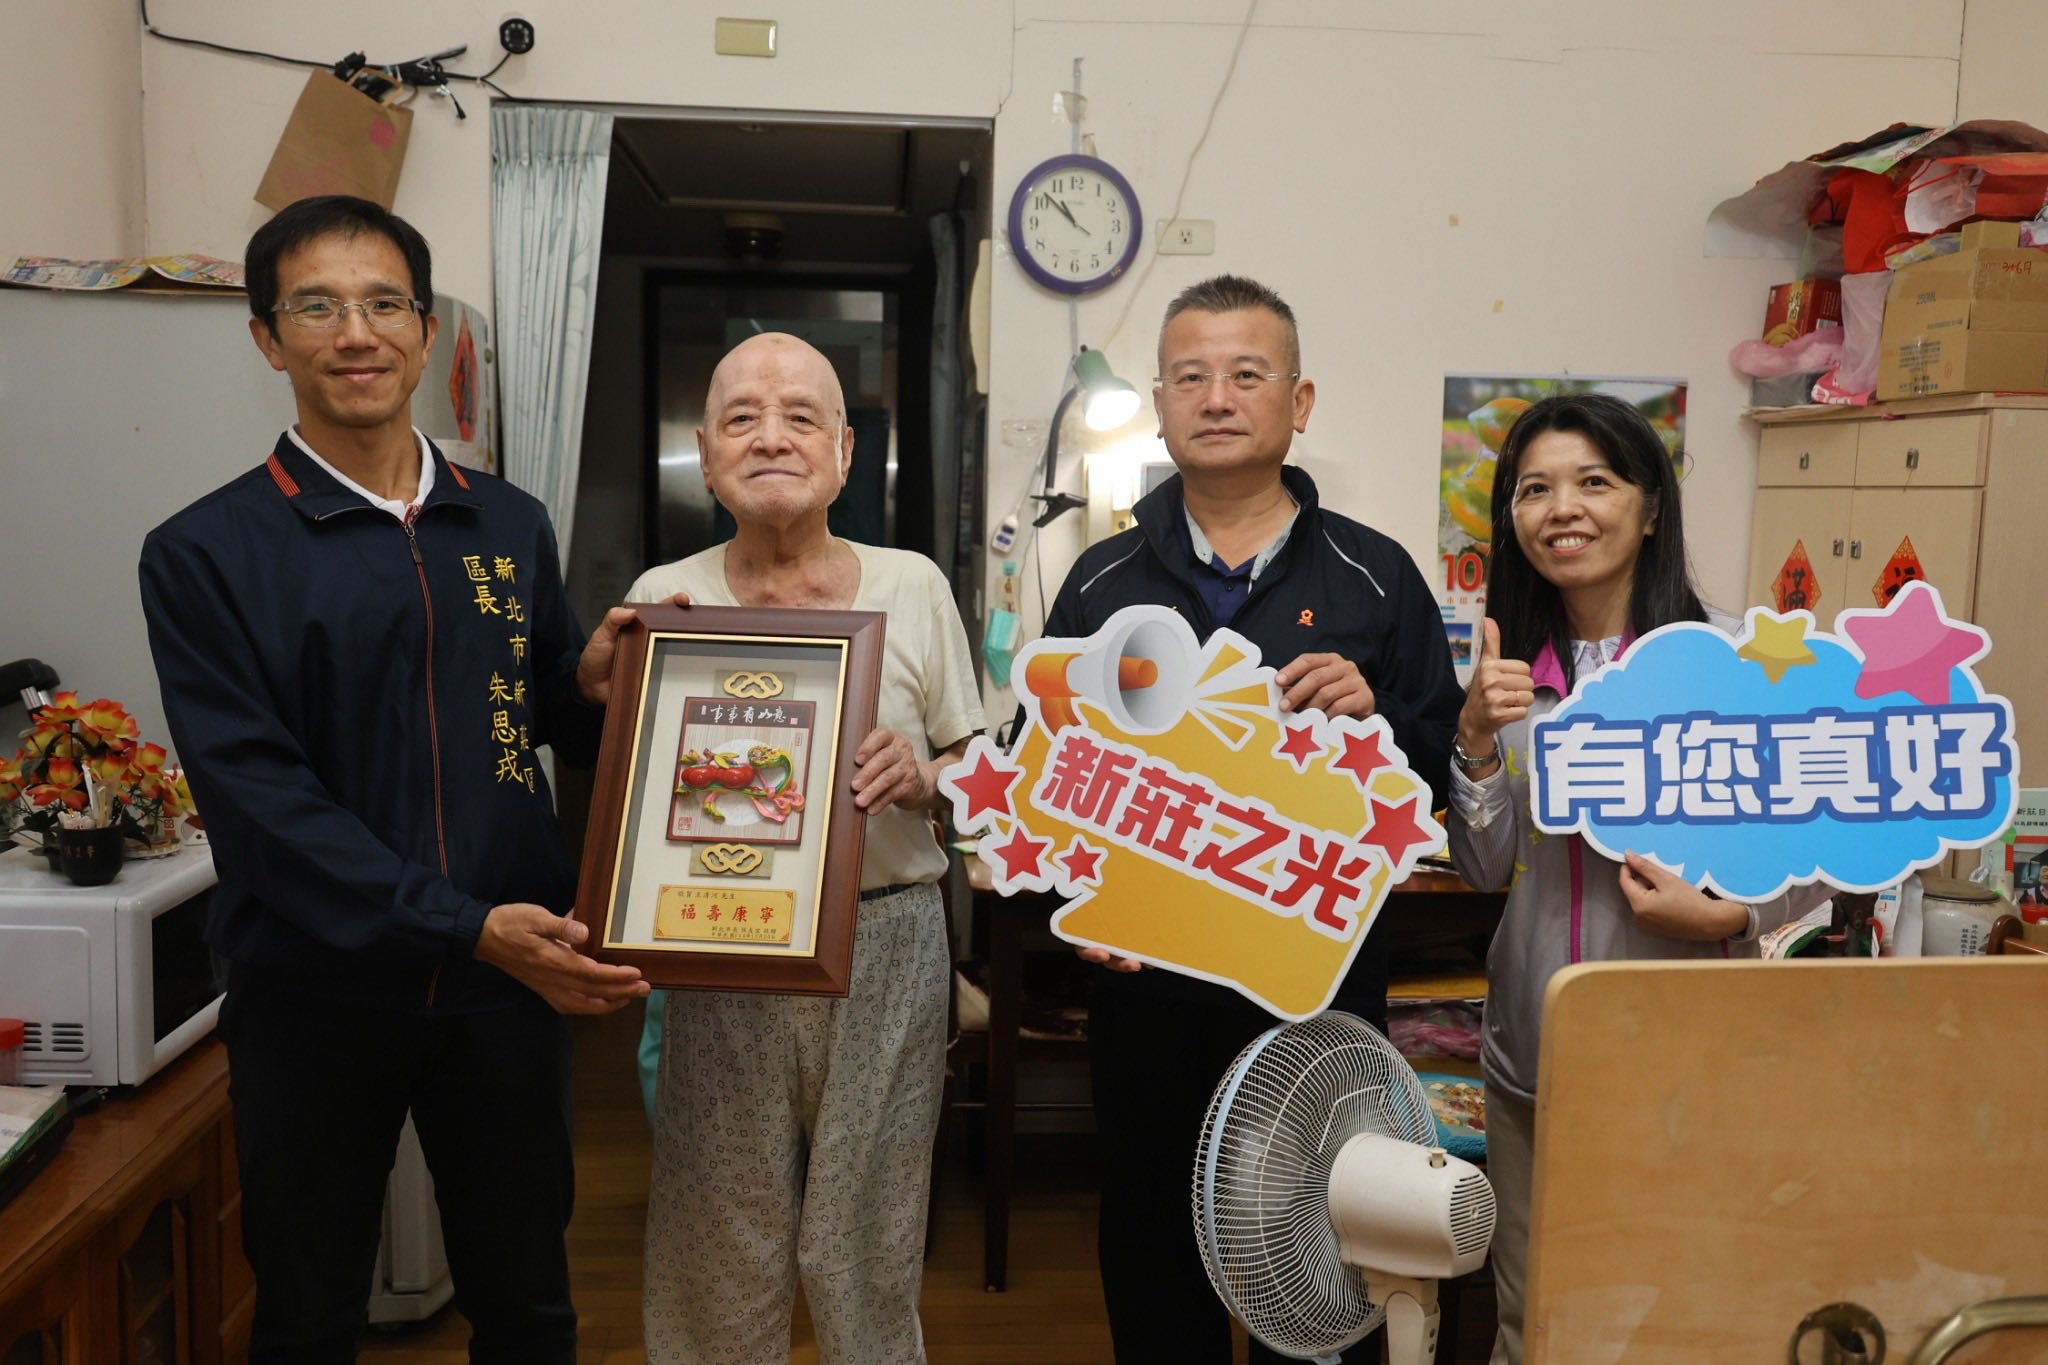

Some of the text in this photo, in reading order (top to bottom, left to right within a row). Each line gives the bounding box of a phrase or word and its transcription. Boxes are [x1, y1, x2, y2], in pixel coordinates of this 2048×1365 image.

[1052, 179, 1064, 193] 11
[1070, 176, 1084, 190] 12
[1096, 183, 1101, 197] 1
[1034, 196, 1049, 210] 10
[1107, 199, 1116, 213] 2
[1029, 216, 1039, 231] 9
[1112, 220, 1121, 234] 3
[1035, 239, 1045, 252] 8
[1105, 240, 1113, 255] 4
[1052, 254, 1060, 269] 7
[1070, 260, 1080, 273] 6
[1091, 254, 1100, 269] 5
[462, 555, 524, 784] 區長 朱思戎
[1544, 712, 2002, 818] 有您真好
[1040, 736, 1371, 931] 新莊之光
[681, 904, 774, 924] 福壽康寧
